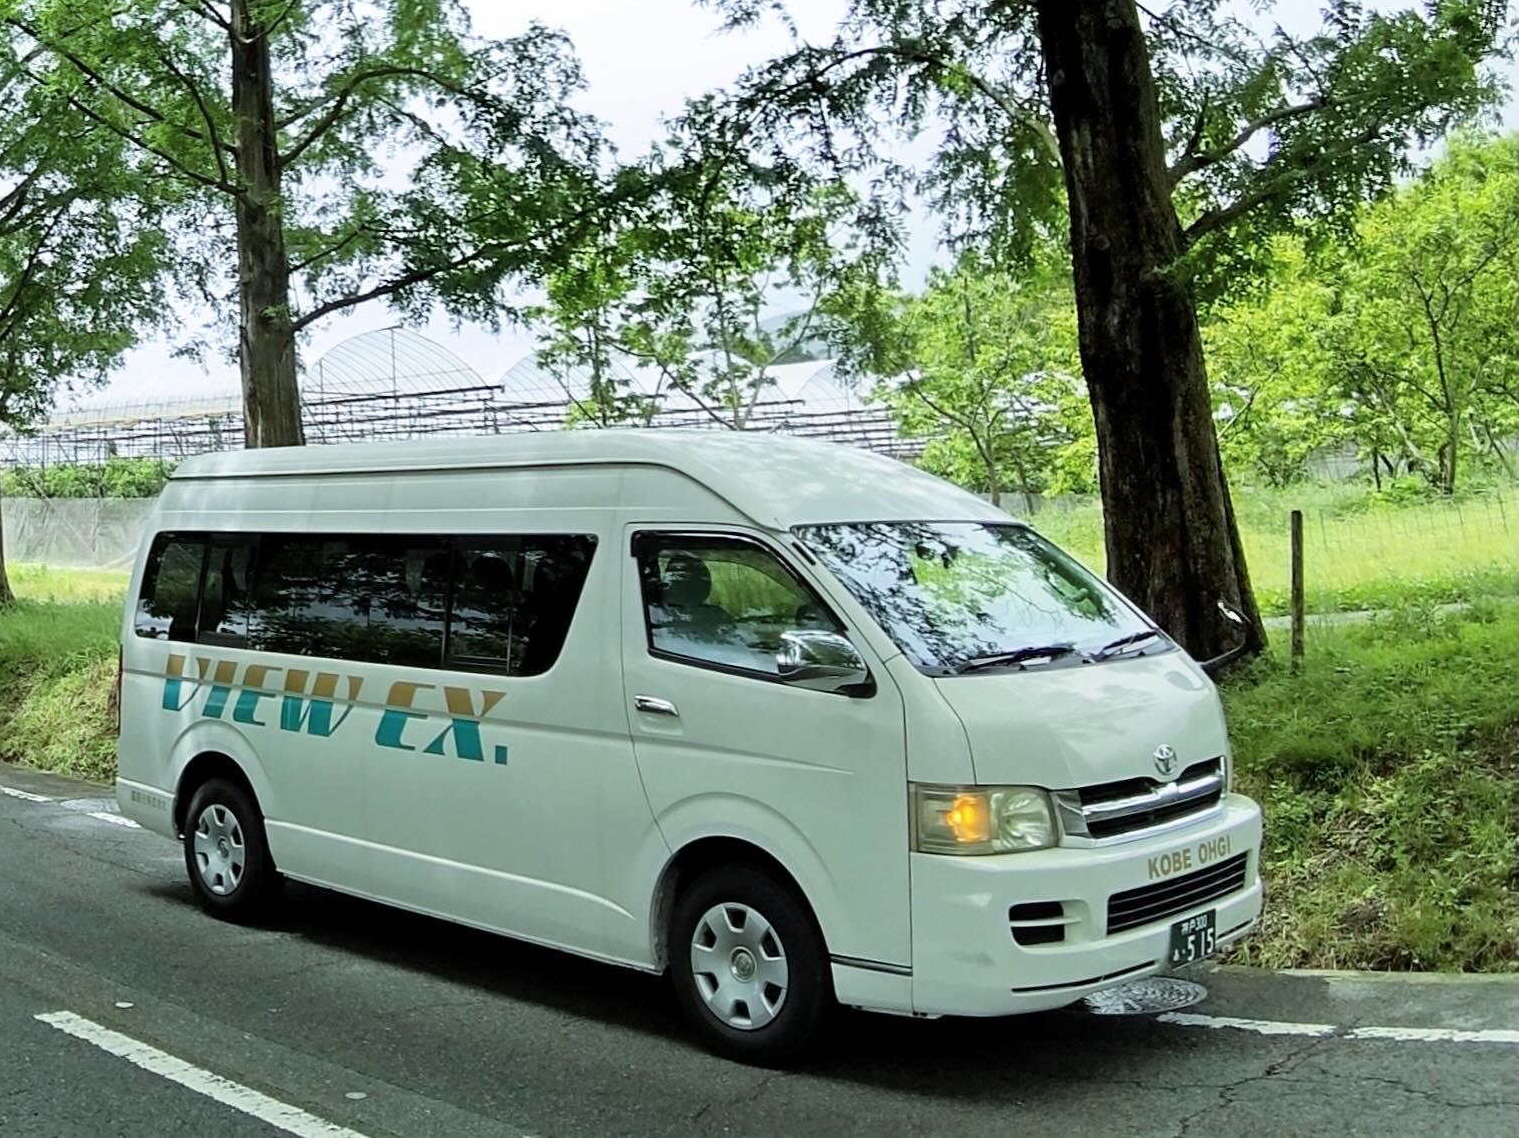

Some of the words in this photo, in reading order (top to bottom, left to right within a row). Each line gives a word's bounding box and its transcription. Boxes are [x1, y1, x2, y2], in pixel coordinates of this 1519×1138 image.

[162, 653, 364, 738] VIEW
[375, 680, 508, 766] EX.
[1148, 847, 1192, 880] KOBE
[1198, 834, 1231, 864] OHGI
